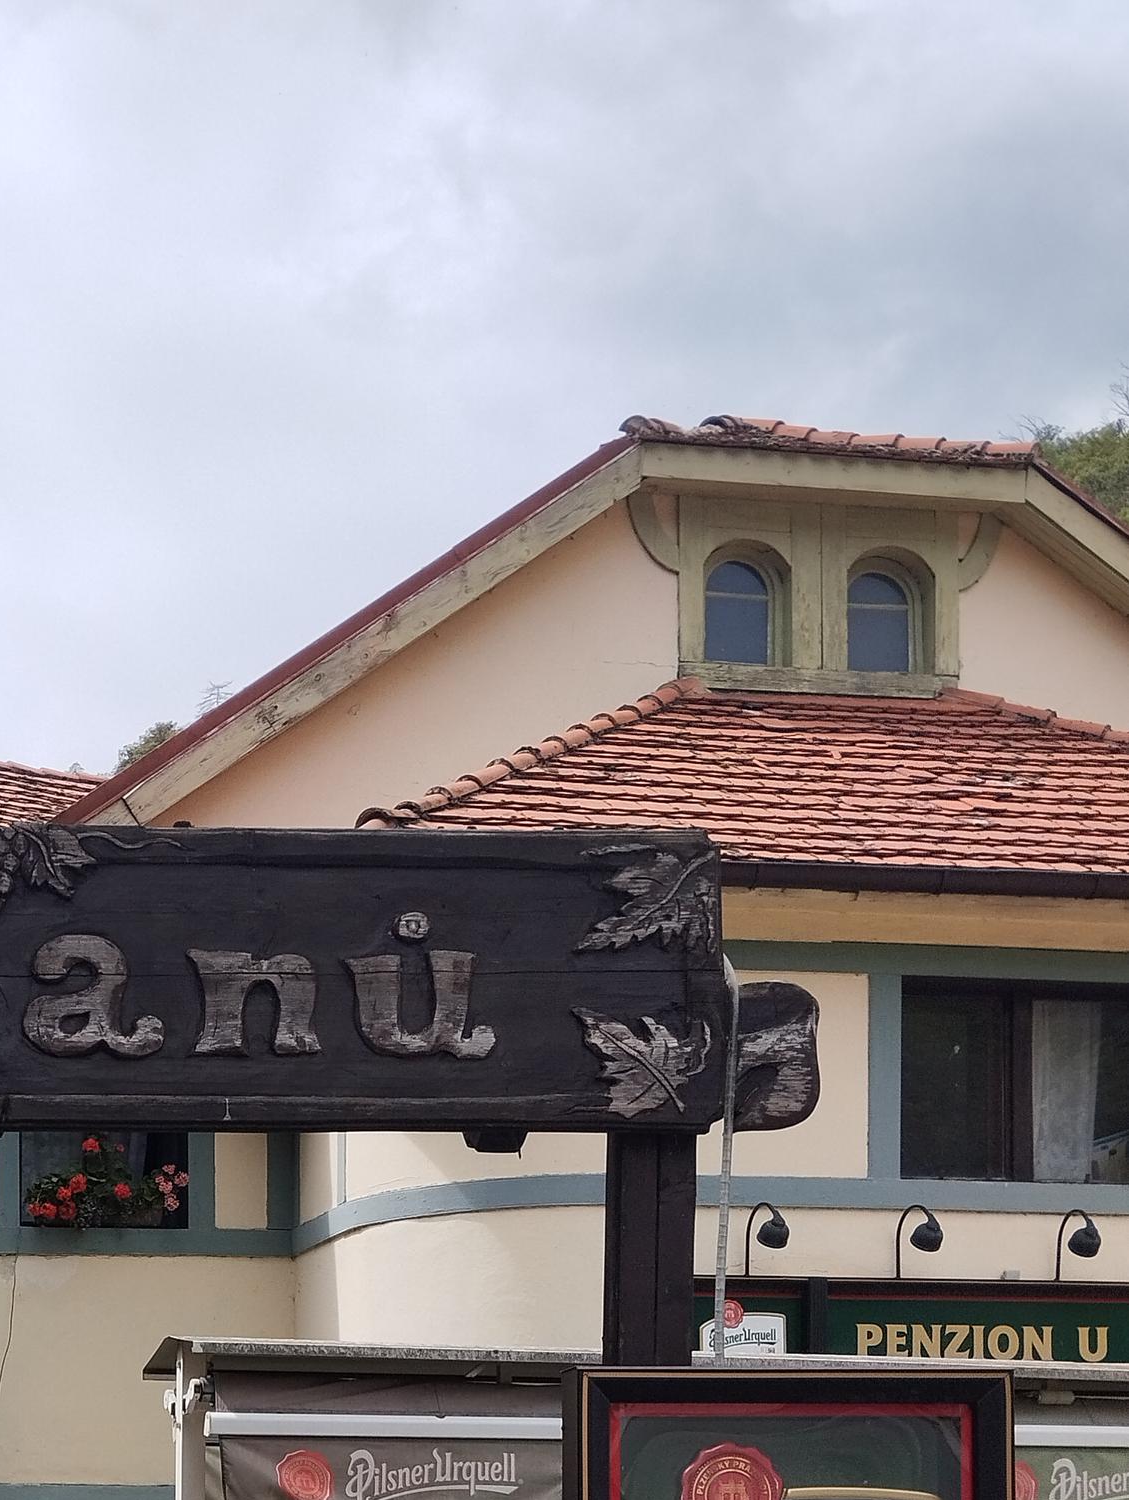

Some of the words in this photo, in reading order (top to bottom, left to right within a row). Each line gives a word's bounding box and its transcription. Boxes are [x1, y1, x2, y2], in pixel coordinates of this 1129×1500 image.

[742, 1327, 777, 1346] Urquell
[855, 1322, 1054, 1361] PENZION
[1077, 1326, 1110, 1362] U
[432, 1447, 519, 1497] Urquell
